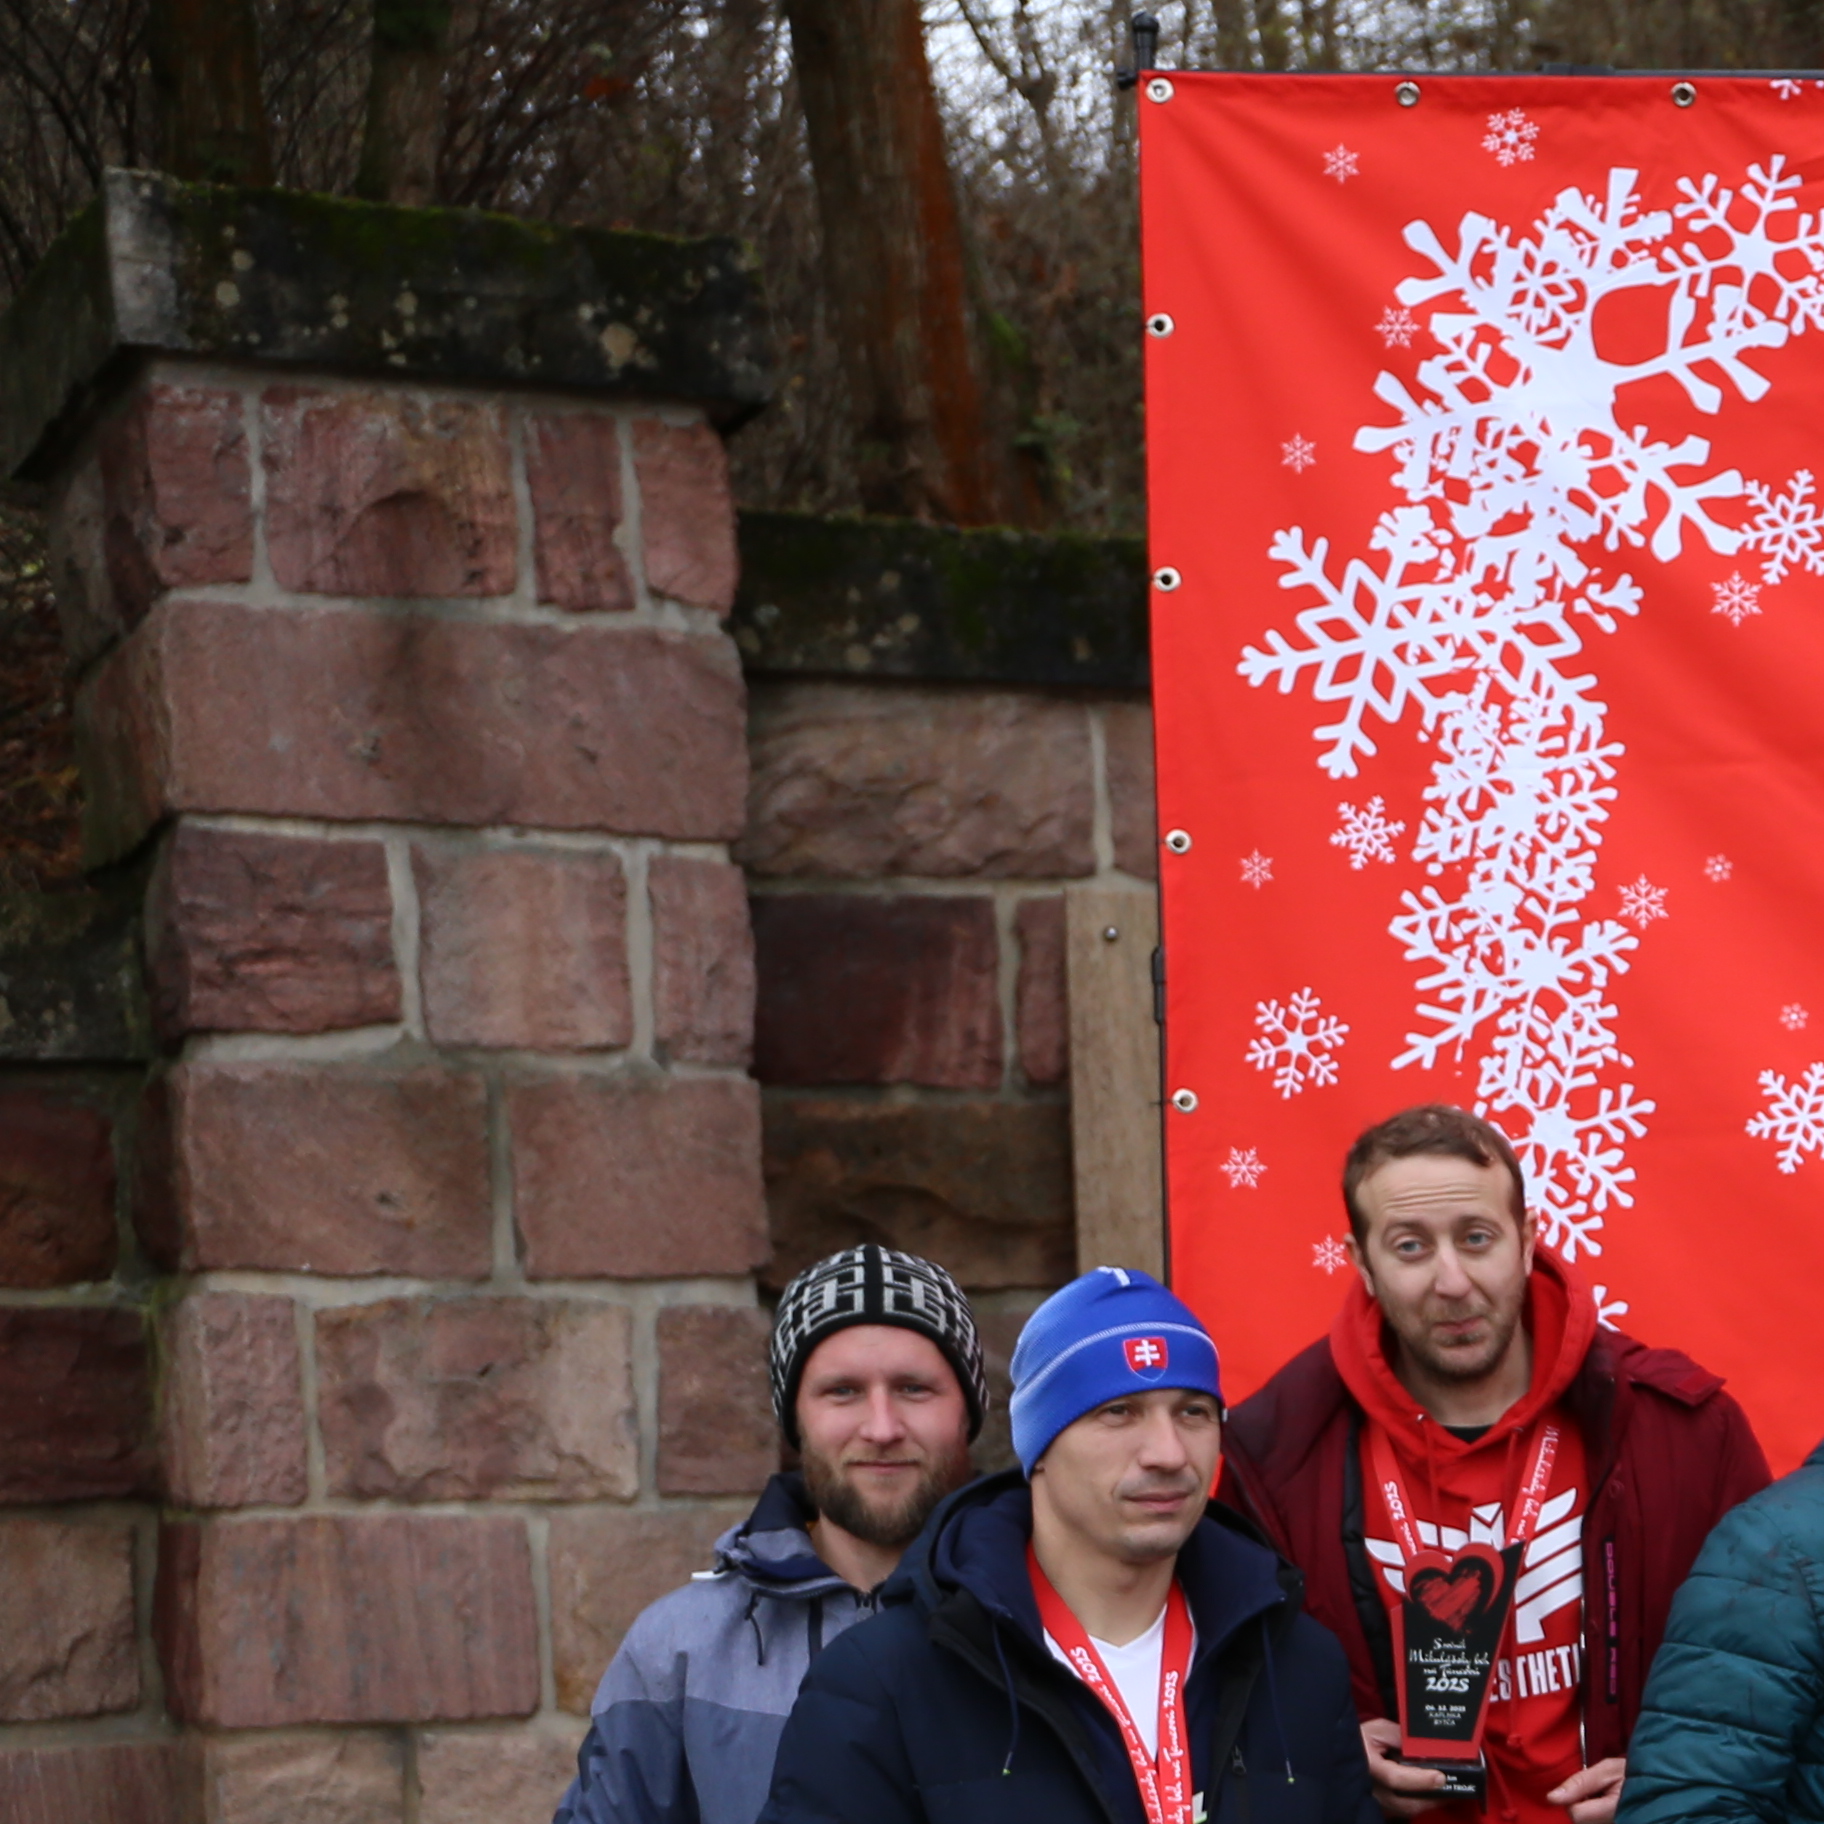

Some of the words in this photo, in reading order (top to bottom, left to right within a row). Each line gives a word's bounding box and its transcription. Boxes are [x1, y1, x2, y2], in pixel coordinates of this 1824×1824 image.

[1605, 1542, 1617, 1636] DOUBLE
[1163, 1671, 1178, 1708] 2025
[1426, 1676, 1469, 1692] 2025
